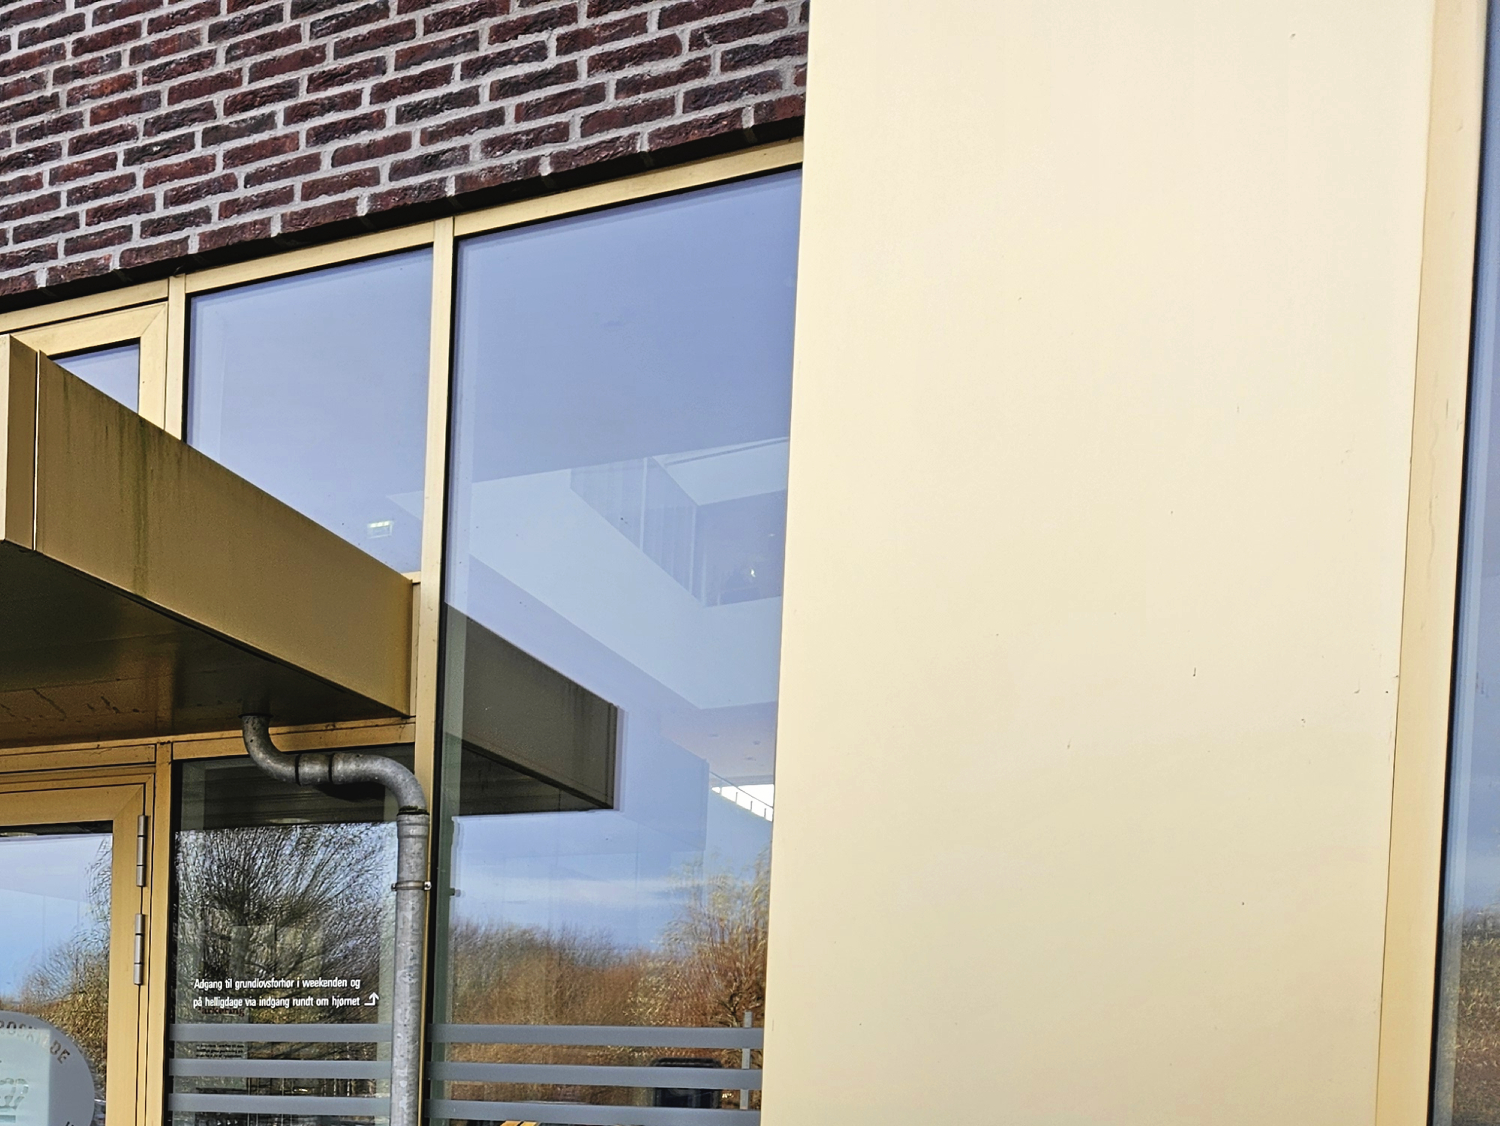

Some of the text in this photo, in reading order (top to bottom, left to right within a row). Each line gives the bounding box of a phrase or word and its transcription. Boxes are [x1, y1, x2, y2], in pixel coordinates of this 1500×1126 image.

[194, 978, 223, 991] Adgang
[225, 977, 233, 989] til
[235, 977, 295, 990] grundlovsforhør
[302, 977, 348, 988] weekenden
[350, 979, 361, 989] og
[193, 995, 360, 1009] på helligdage via indgang rundt om hjørnet
